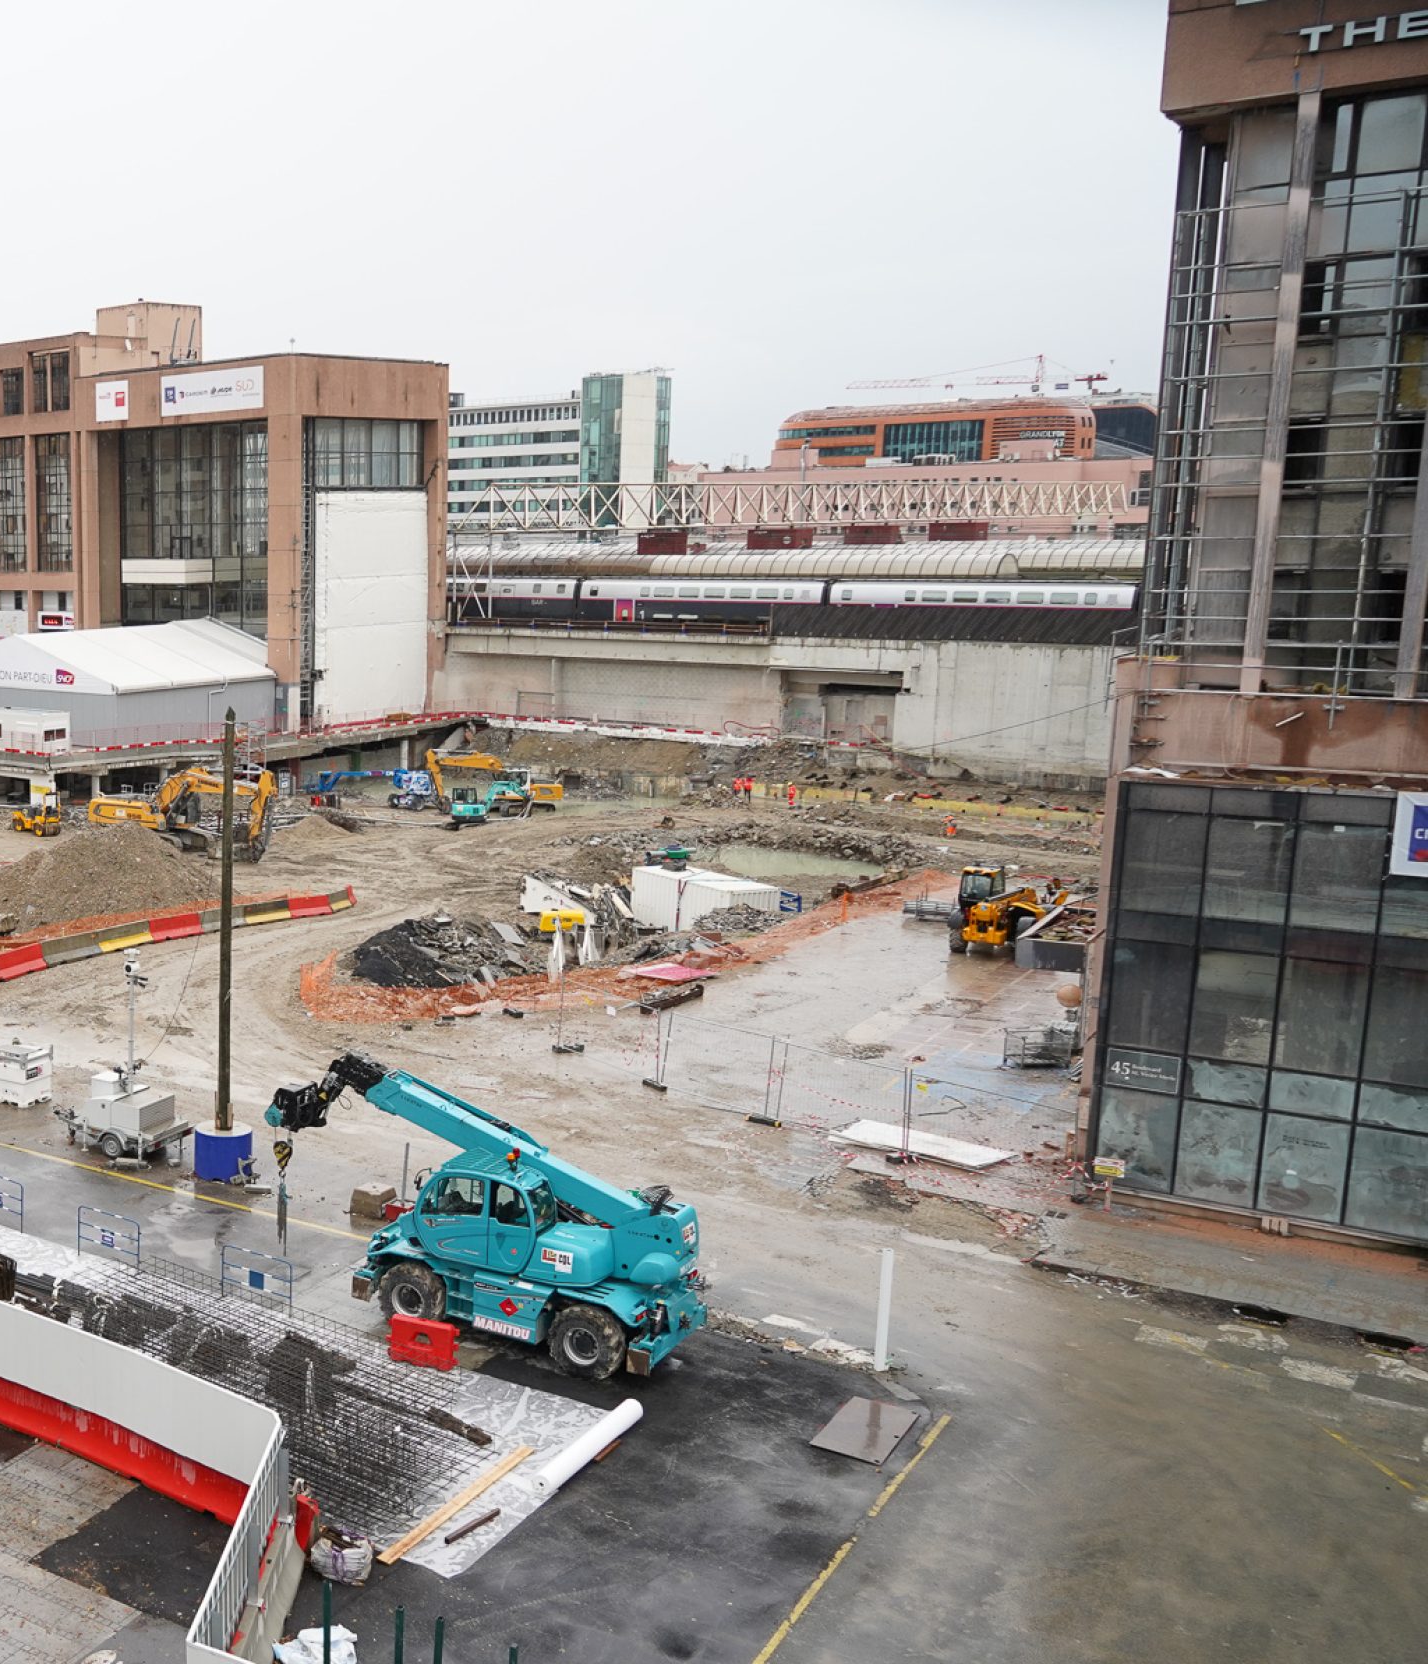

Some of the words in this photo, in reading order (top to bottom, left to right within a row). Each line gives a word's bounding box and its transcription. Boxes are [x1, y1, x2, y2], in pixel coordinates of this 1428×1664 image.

[13, 673, 52, 684] PART-DIEU
[1111, 1060, 1132, 1075] 45
[473, 1315, 531, 1340] MANITOU
